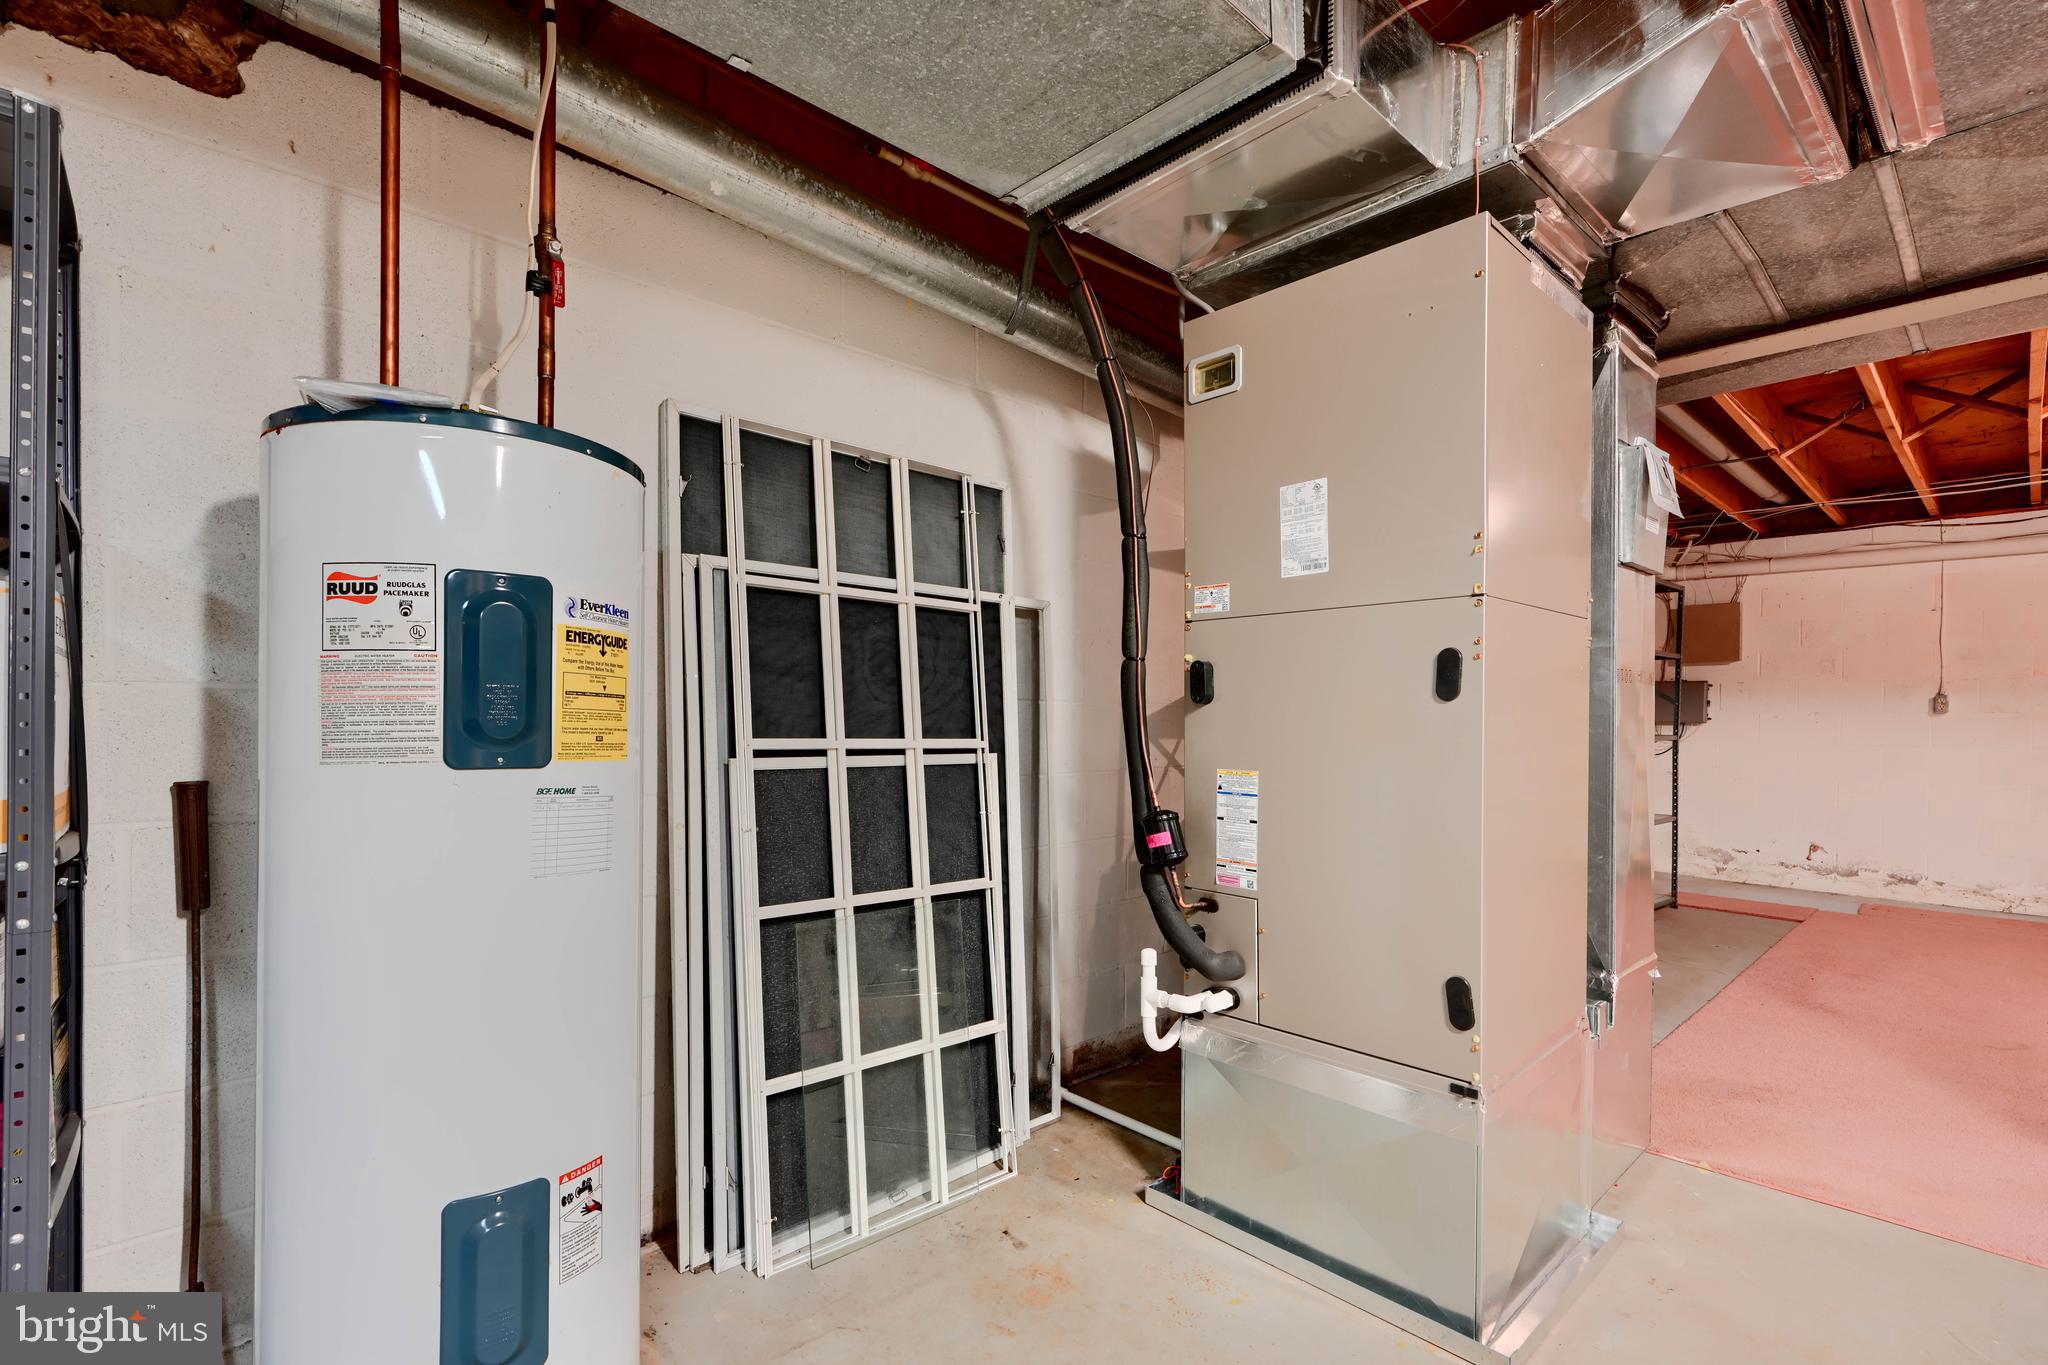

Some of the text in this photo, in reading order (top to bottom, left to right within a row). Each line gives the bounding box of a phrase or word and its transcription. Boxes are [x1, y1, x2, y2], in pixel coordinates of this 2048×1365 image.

[327, 582, 378, 595] RUUD
[580, 599, 629, 619] EverKleen
[566, 629, 628, 650] ENERGYGUIDE
[570, 1158, 601, 1178] DANGER
